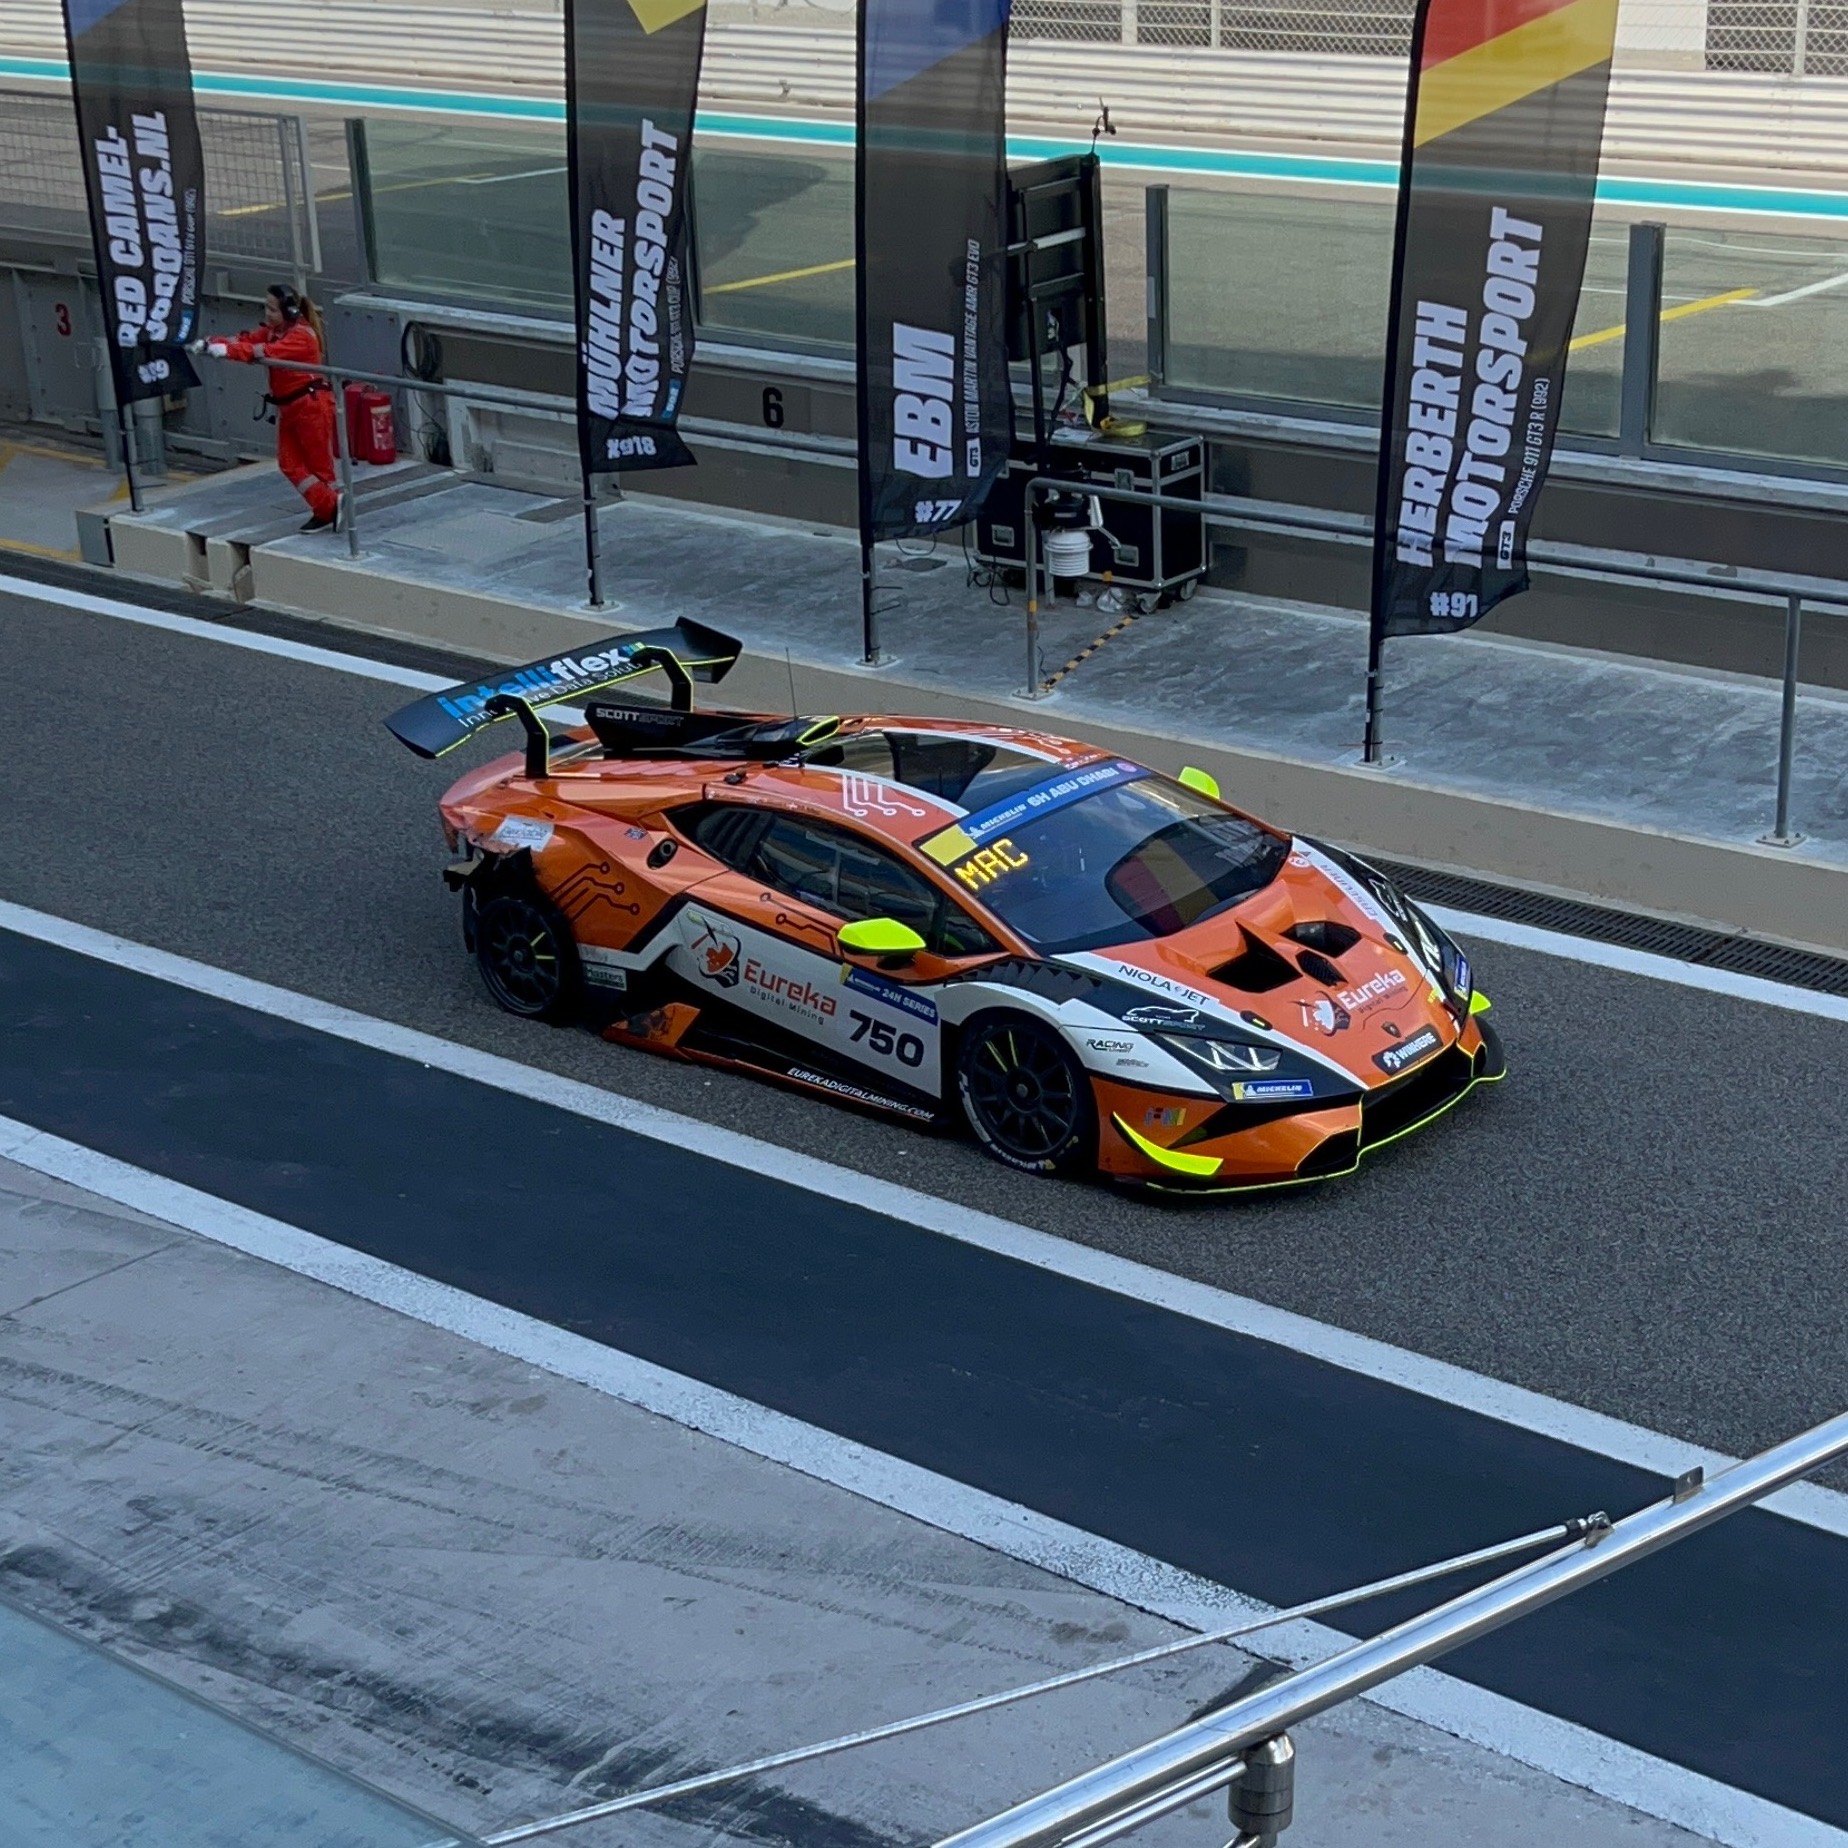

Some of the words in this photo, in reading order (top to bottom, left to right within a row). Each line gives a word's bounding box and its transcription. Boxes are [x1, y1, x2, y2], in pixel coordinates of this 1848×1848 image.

[95, 125, 145, 268] CAMEL-
[131, 111, 184, 341] JORDANS.NL
[619, 118, 678, 418] MOTORSPORT
[967, 238, 980, 262] EVO
[966, 263, 979, 284] GT3
[55, 303, 71, 336] 3
[114, 275, 147, 347] RED
[582, 209, 625, 421] MÜHLNER
[762, 386, 785, 429] 6
[893, 322, 955, 479] EBM
[1444, 206, 1543, 569] MOTORSPORT
[1530, 378, 1551, 410] (992)
[1397, 300, 1468, 569] HERBERTH
[1526, 423, 1545, 446] GT3
[1530, 411, 1545, 421] R
[1521, 446, 1541, 466] 911
[914, 500, 962, 523] #77
[1508, 466, 1536, 514] PORSCHE
[1499, 531, 1512, 561] GT3
[1429, 591, 1478, 618] #91
[980, 803, 1028, 831] MICHELIN
[1027, 792, 1051, 808] 6H
[1050, 781, 1080, 799] ABU
[1079, 767, 1120, 788] DHABI
[954, 837, 1030, 891] MAC
[744, 958, 837, 1017] Eureka
[750, 985, 788, 1008] Digital
[789, 1002, 825, 1026] Mining
[882, 988, 902, 1003] 24H
[902, 997, 936, 1018] SERIES
[1118, 963, 1172, 993] NIOLA
[1181, 988, 1211, 1006] JET
[1337, 969, 1406, 1010] Eureka
[849, 1010, 925, 1068] 750
[1086, 1038, 1135, 1052] RACING
[786, 1067, 935, 1120] EUREKADIGITALMINING.COM
[1256, 1083, 1303, 1094] MICHELIN
